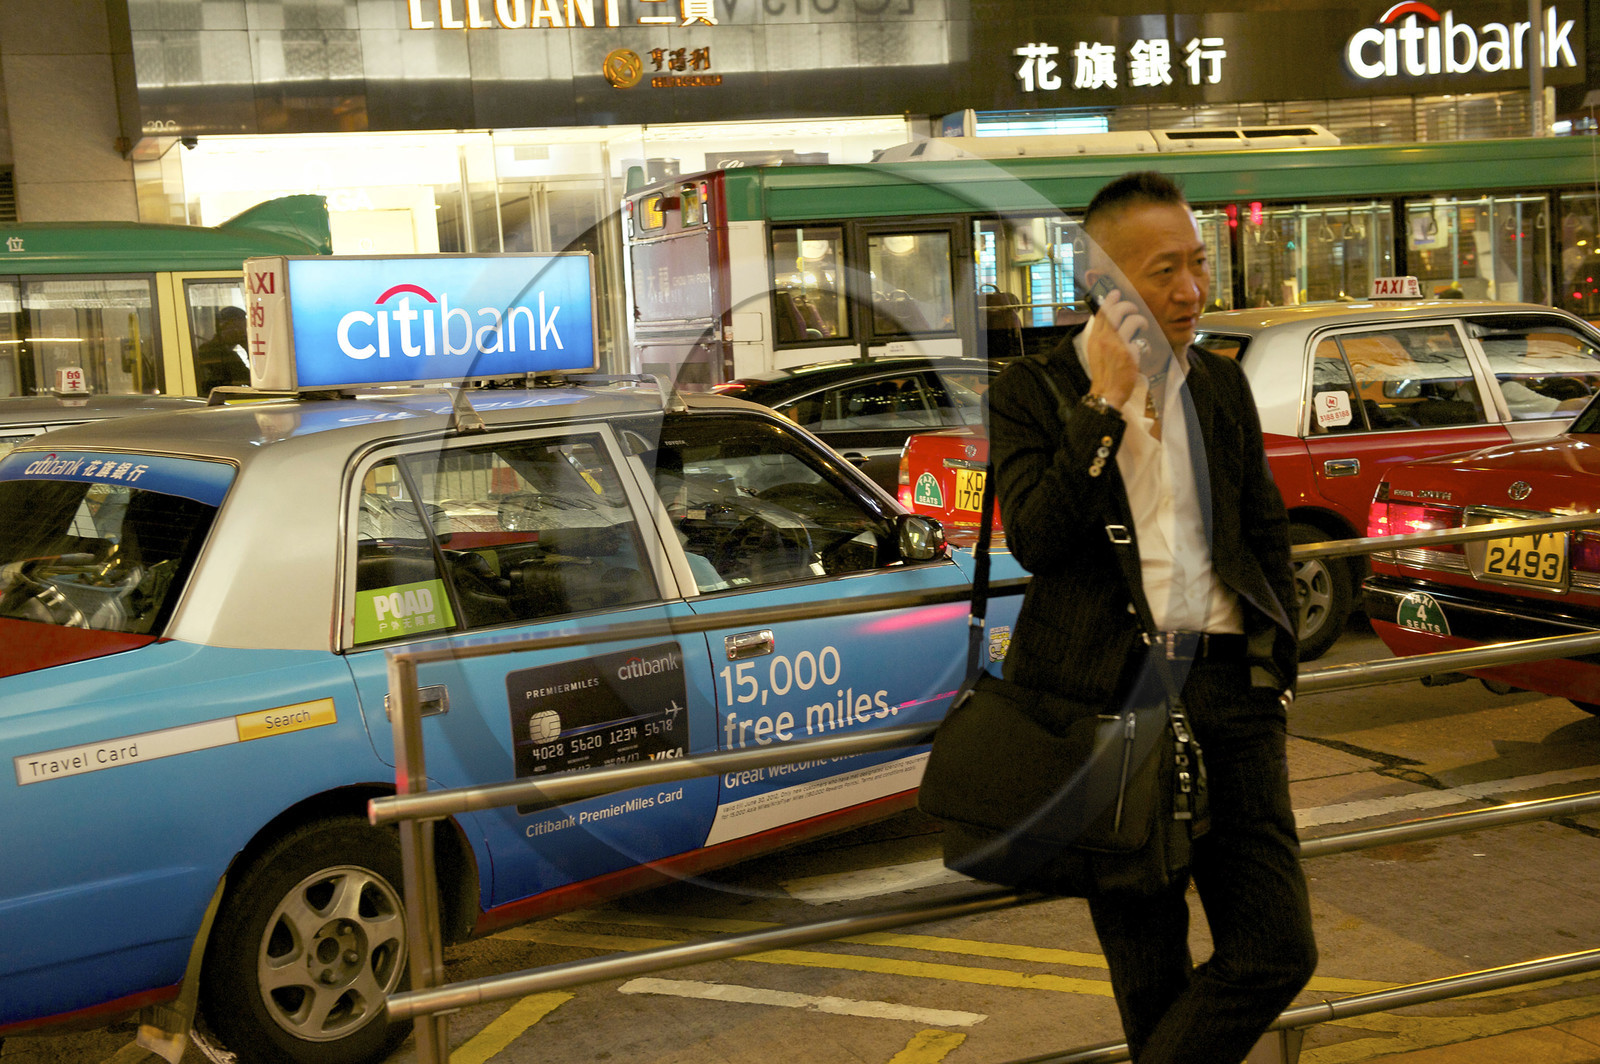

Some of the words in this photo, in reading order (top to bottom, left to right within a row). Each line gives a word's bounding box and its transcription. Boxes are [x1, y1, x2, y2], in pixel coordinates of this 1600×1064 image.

[1347, 4, 1577, 79] citibank
[1013, 37, 1227, 92] 花旗銀行
[6, 236, 25, 252] 位
[243, 272, 275, 294] AXI
[1375, 279, 1404, 294] TAXI
[250, 302, 266, 356] 的士
[337, 285, 564, 359] citibank
[24, 455, 84, 476] citibank
[83, 460, 149, 481] 花旗銀行
[919, 475, 935, 487] TAXI
[925, 483, 931, 496] 5
[966, 472, 984, 491] KD
[919, 496, 939, 505] SEATS
[1488, 547, 1560, 580] 2493
[373, 588, 434, 621] POAD
[1410, 594, 1433, 609] TAXI
[1416, 604, 1427, 621] 4
[1406, 619, 1441, 633] SEATS
[618, 652, 678, 681] citibank
[719, 646, 841, 706] 15,000
[526, 678, 600, 699] PREMIERMILES
[265, 709, 312, 730] Search
[724, 711, 794, 750] free
[806, 688, 898, 735] miles.
[532, 744, 565, 761] 4028
[571, 735, 603, 754] 5620
[609, 726, 638, 745] 1234
[645, 718, 673, 737] 5678
[29, 752, 89, 777] Travel
[96, 743, 139, 764] Card
[648, 747, 685, 762] VISA
[724, 766, 766, 789] Great
[526, 816, 576, 838] Citibank
[579, 796, 655, 825] PremierMiles
[657, 788, 683, 805] Card
